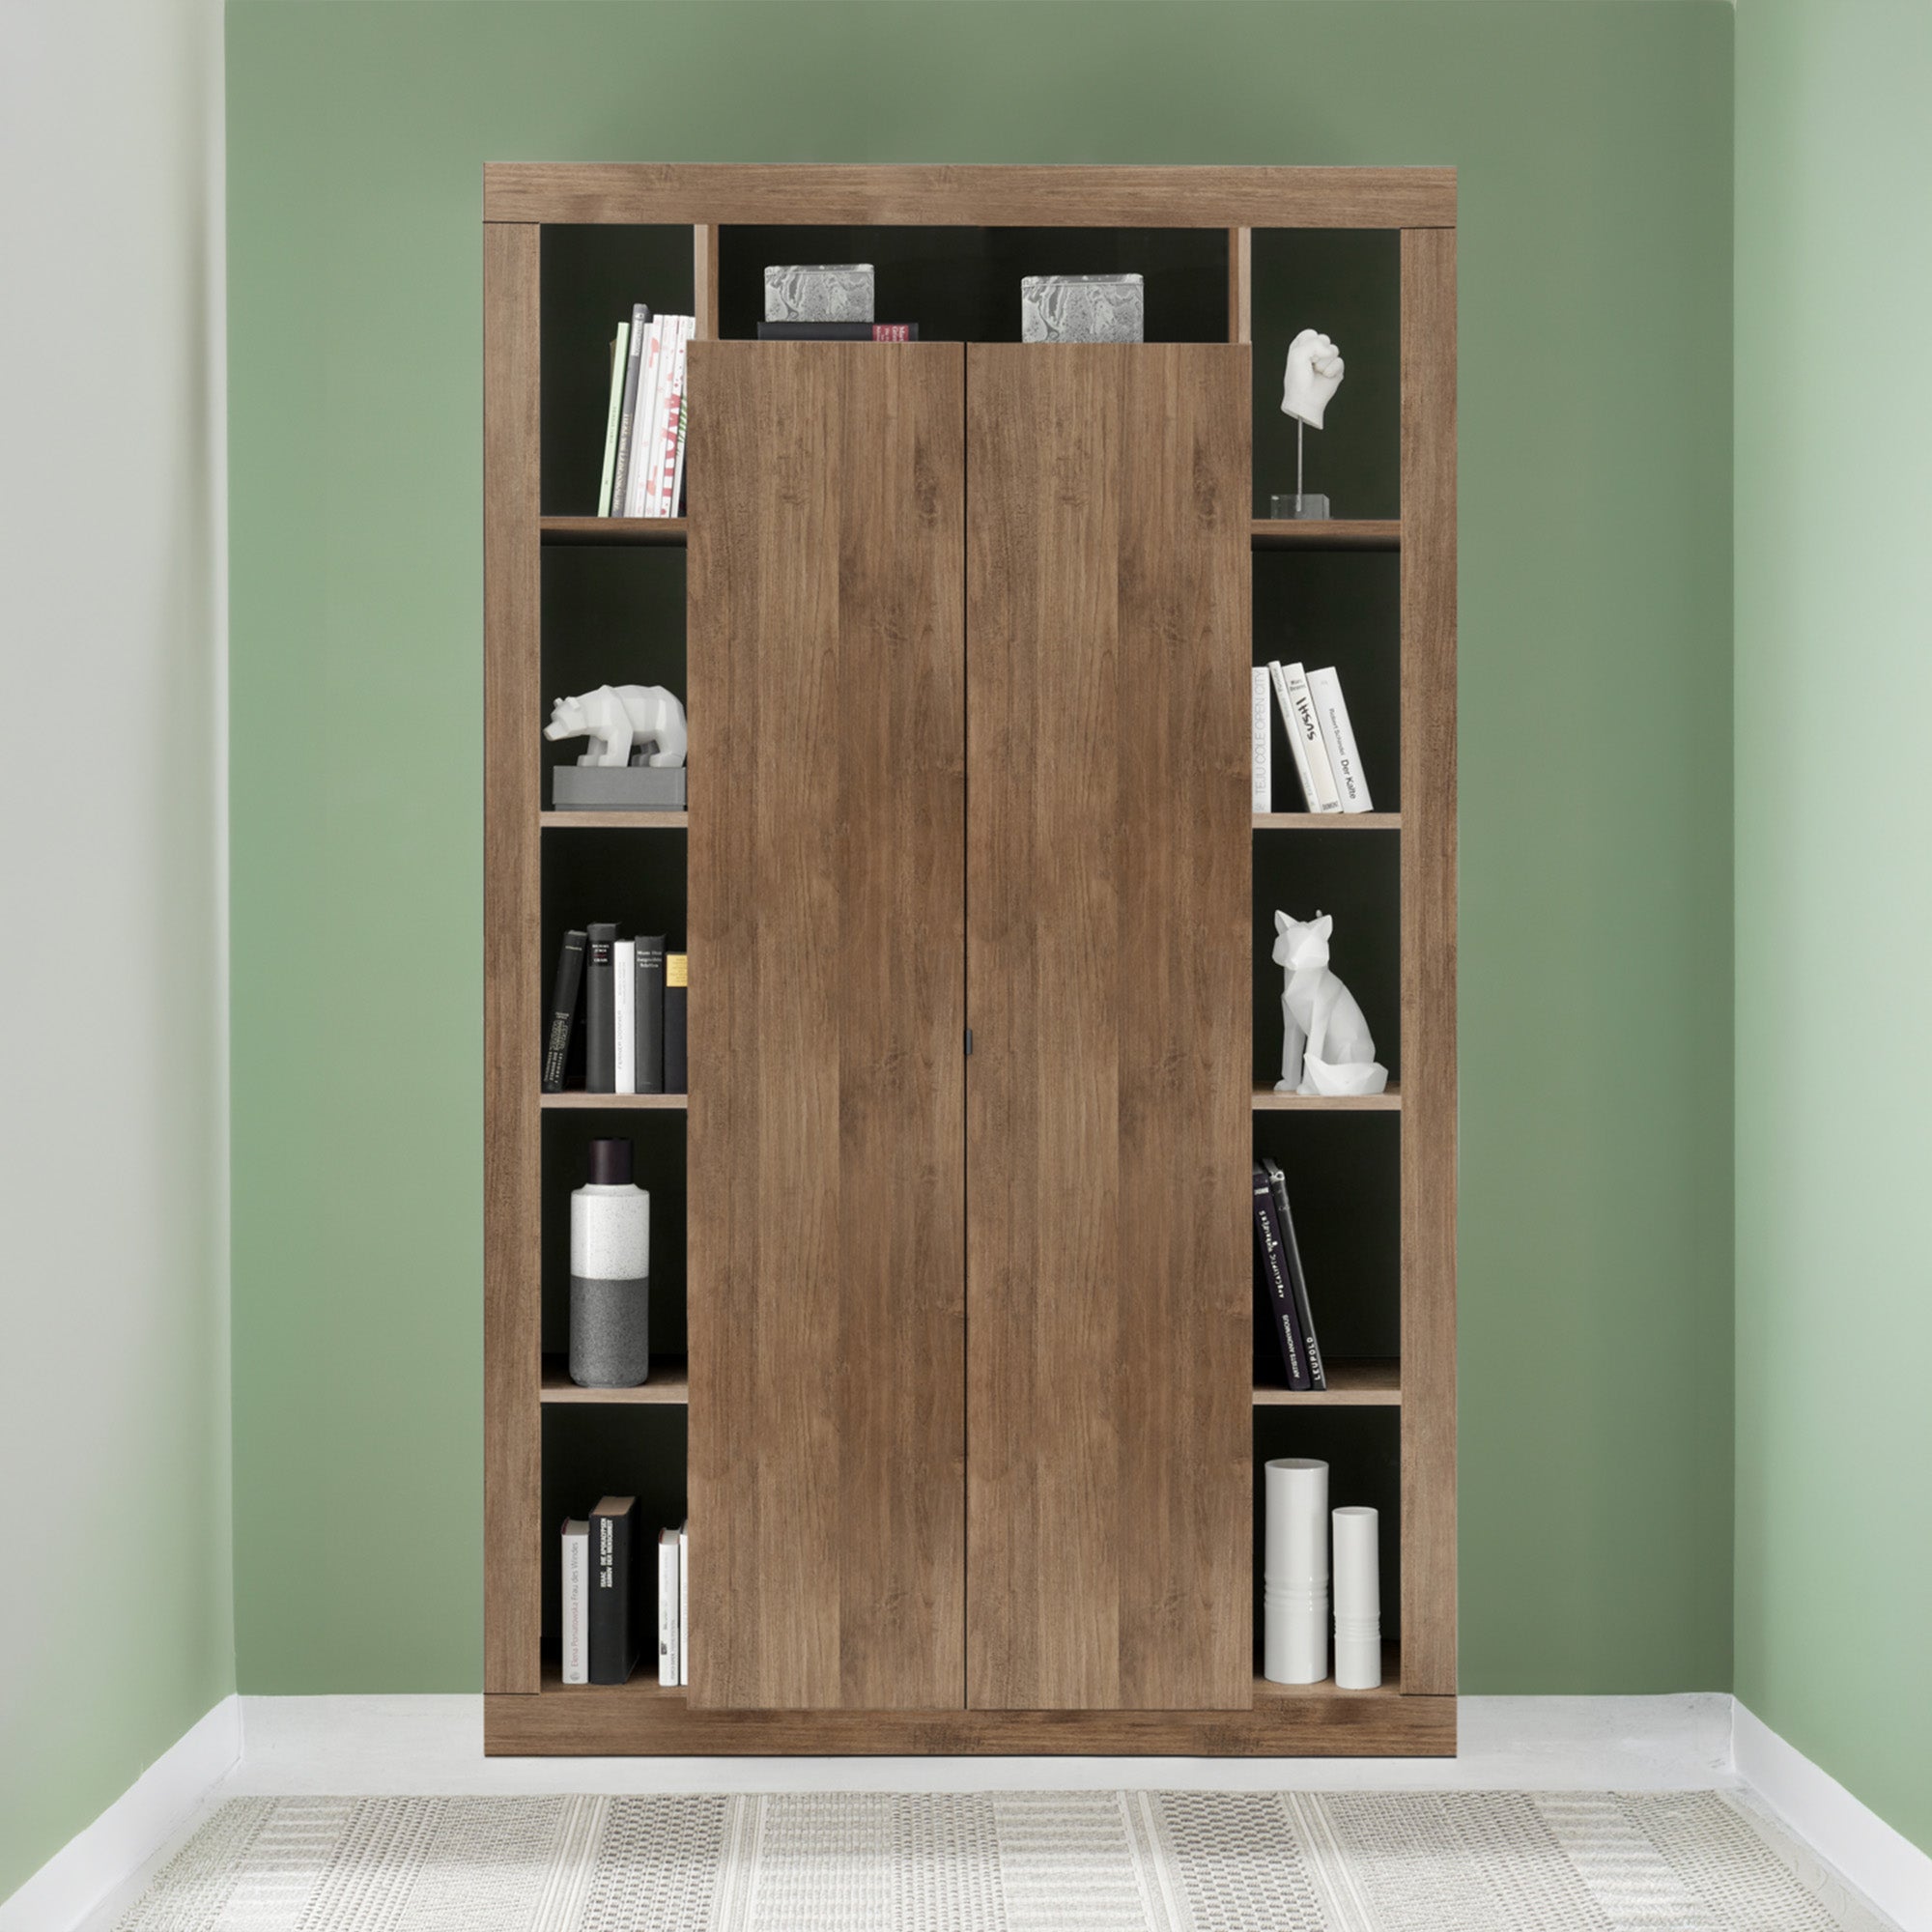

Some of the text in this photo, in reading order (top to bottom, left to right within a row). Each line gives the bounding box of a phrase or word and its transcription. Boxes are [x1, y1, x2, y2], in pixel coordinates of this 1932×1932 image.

[1254, 670, 1265, 794] TEJU COLE OPEN CITY
[1295, 696, 1318, 741] SUSHI
[1341, 759, 1351, 776] Der
[1269, 1254, 1286, 1298] APOCALYPTIC
[1281, 1314, 1300, 1378] ARTISTS ANONYMOUS
